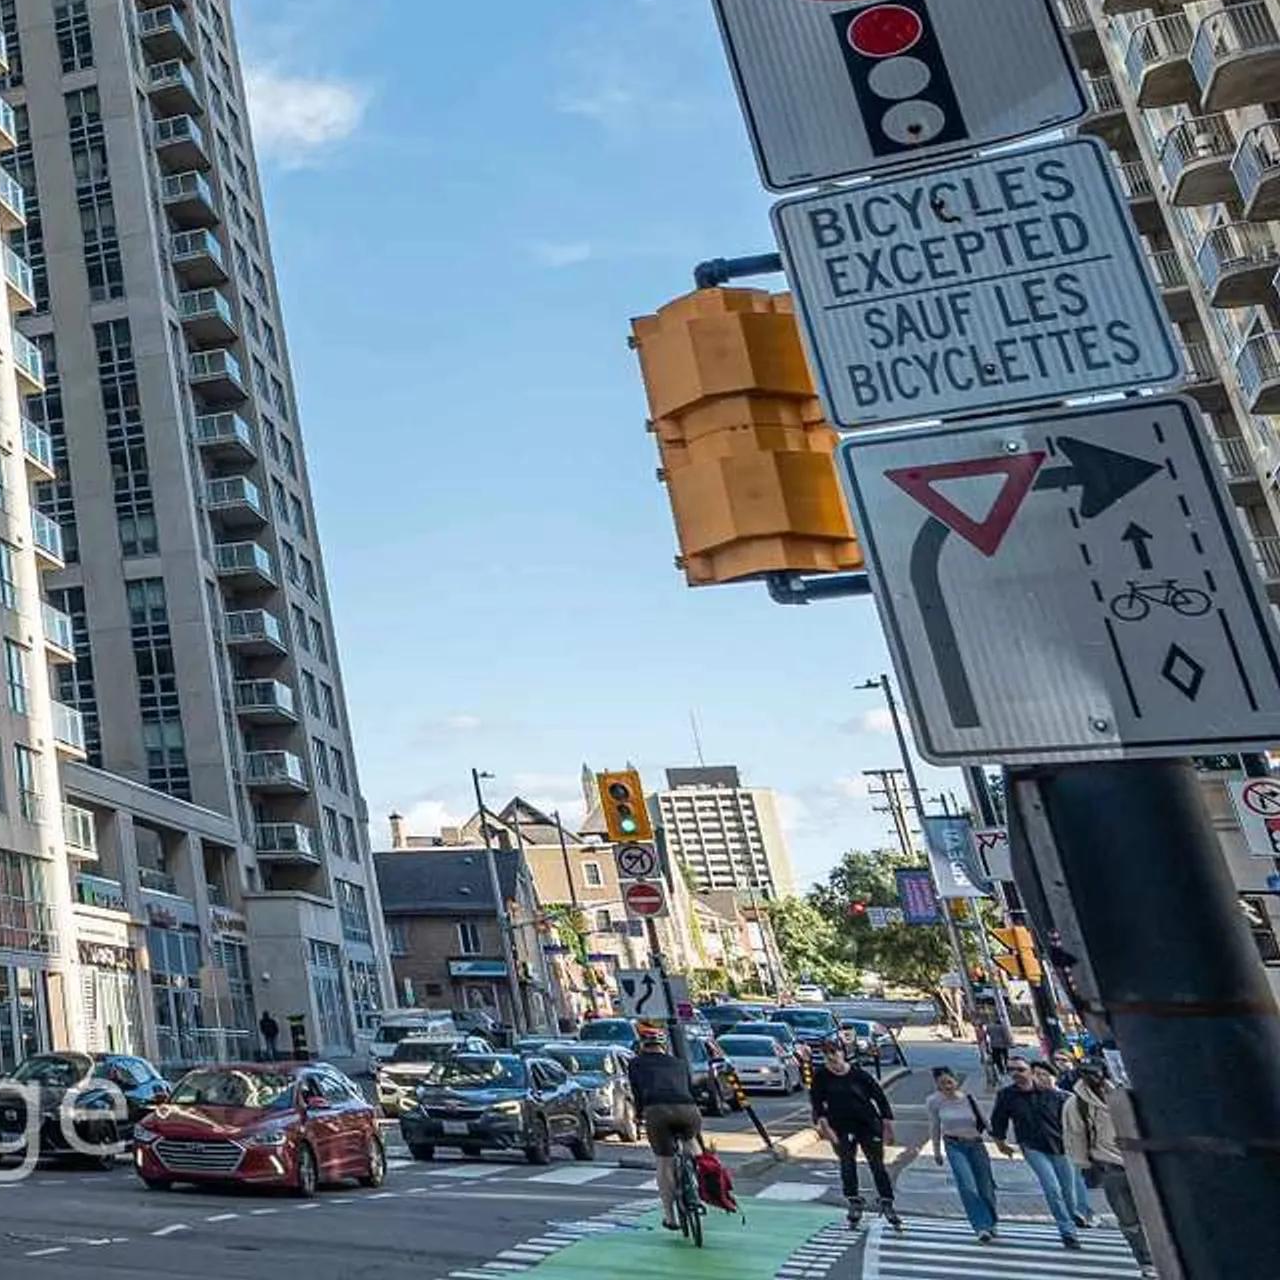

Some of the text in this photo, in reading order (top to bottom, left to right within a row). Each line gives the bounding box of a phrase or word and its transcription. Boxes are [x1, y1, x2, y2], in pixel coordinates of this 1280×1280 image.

[808, 159, 1075, 249] BICYCLES
[825, 210, 1090, 298] EXCEPTED
[864, 273, 1090, 350] SAUF LES
[847, 320, 1140, 408] BICYCLETTES
